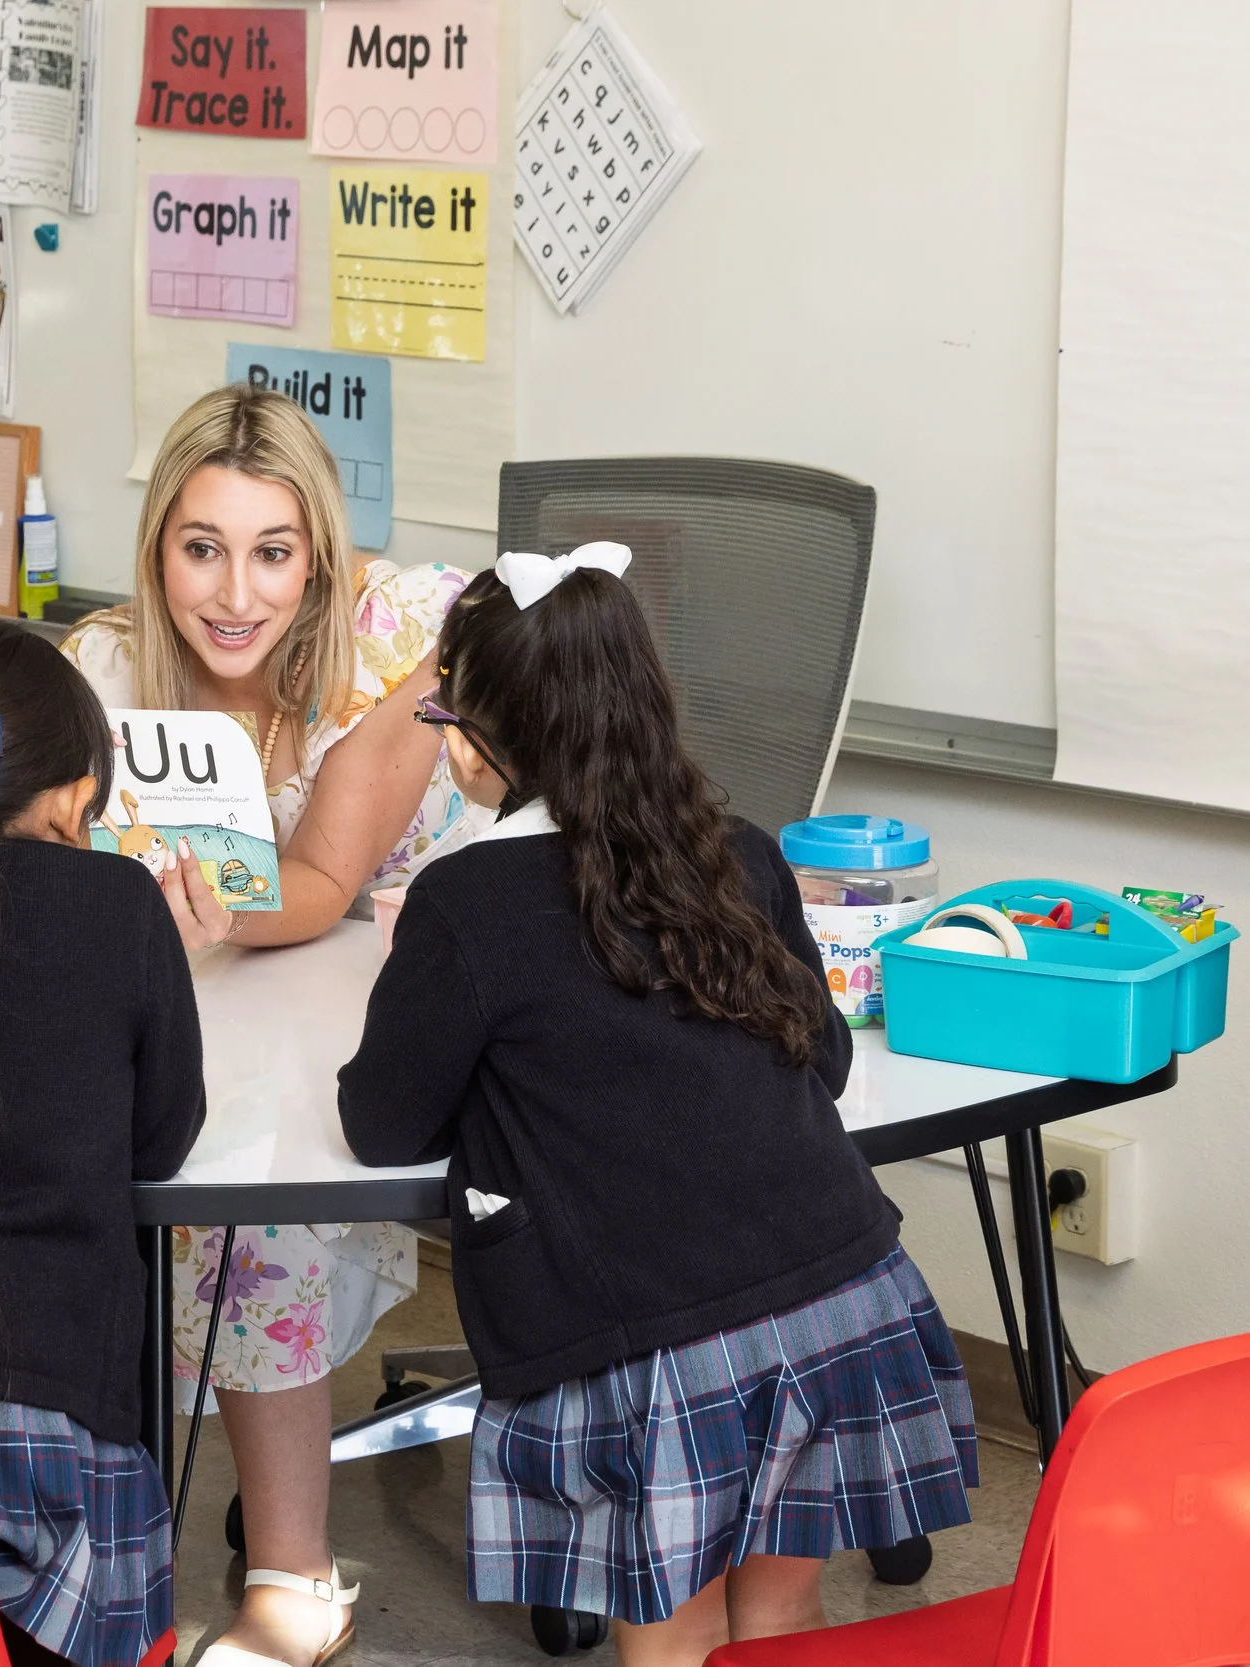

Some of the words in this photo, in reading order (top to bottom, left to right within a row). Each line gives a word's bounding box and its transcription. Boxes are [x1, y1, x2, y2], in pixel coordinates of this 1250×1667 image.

[170, 24, 234, 79] Say
[245, 26, 277, 72] it.
[347, 24, 431, 80] Map
[444, 24, 468, 70] it
[150, 80, 249, 128] Trace
[260, 86, 293, 131] it.
[580, 59, 593, 76] c
[606, 108, 624, 126] j
[622, 129, 640, 156] m
[640, 158, 655, 173] f
[530, 161, 544, 177] d
[557, 86, 570, 106] n
[572, 107, 585, 131] h
[586, 133, 604, 156] w
[602, 157, 616, 179] b
[615, 186, 631, 205] p
[339, 180, 436, 230] Write
[450, 186, 476, 233] it
[553, 138, 566, 155] v
[567, 164, 580, 182] s
[582, 189, 596, 208] x
[594, 215, 611, 235] g
[153, 190, 257, 247] Graph
[269, 197, 291, 241] it
[541, 243, 554, 259] o
[343, 375, 367, 421] it
[818, 930, 842, 942] Mini
[873, 914, 889, 927] 3+
[830, 944, 871, 961] Pops
